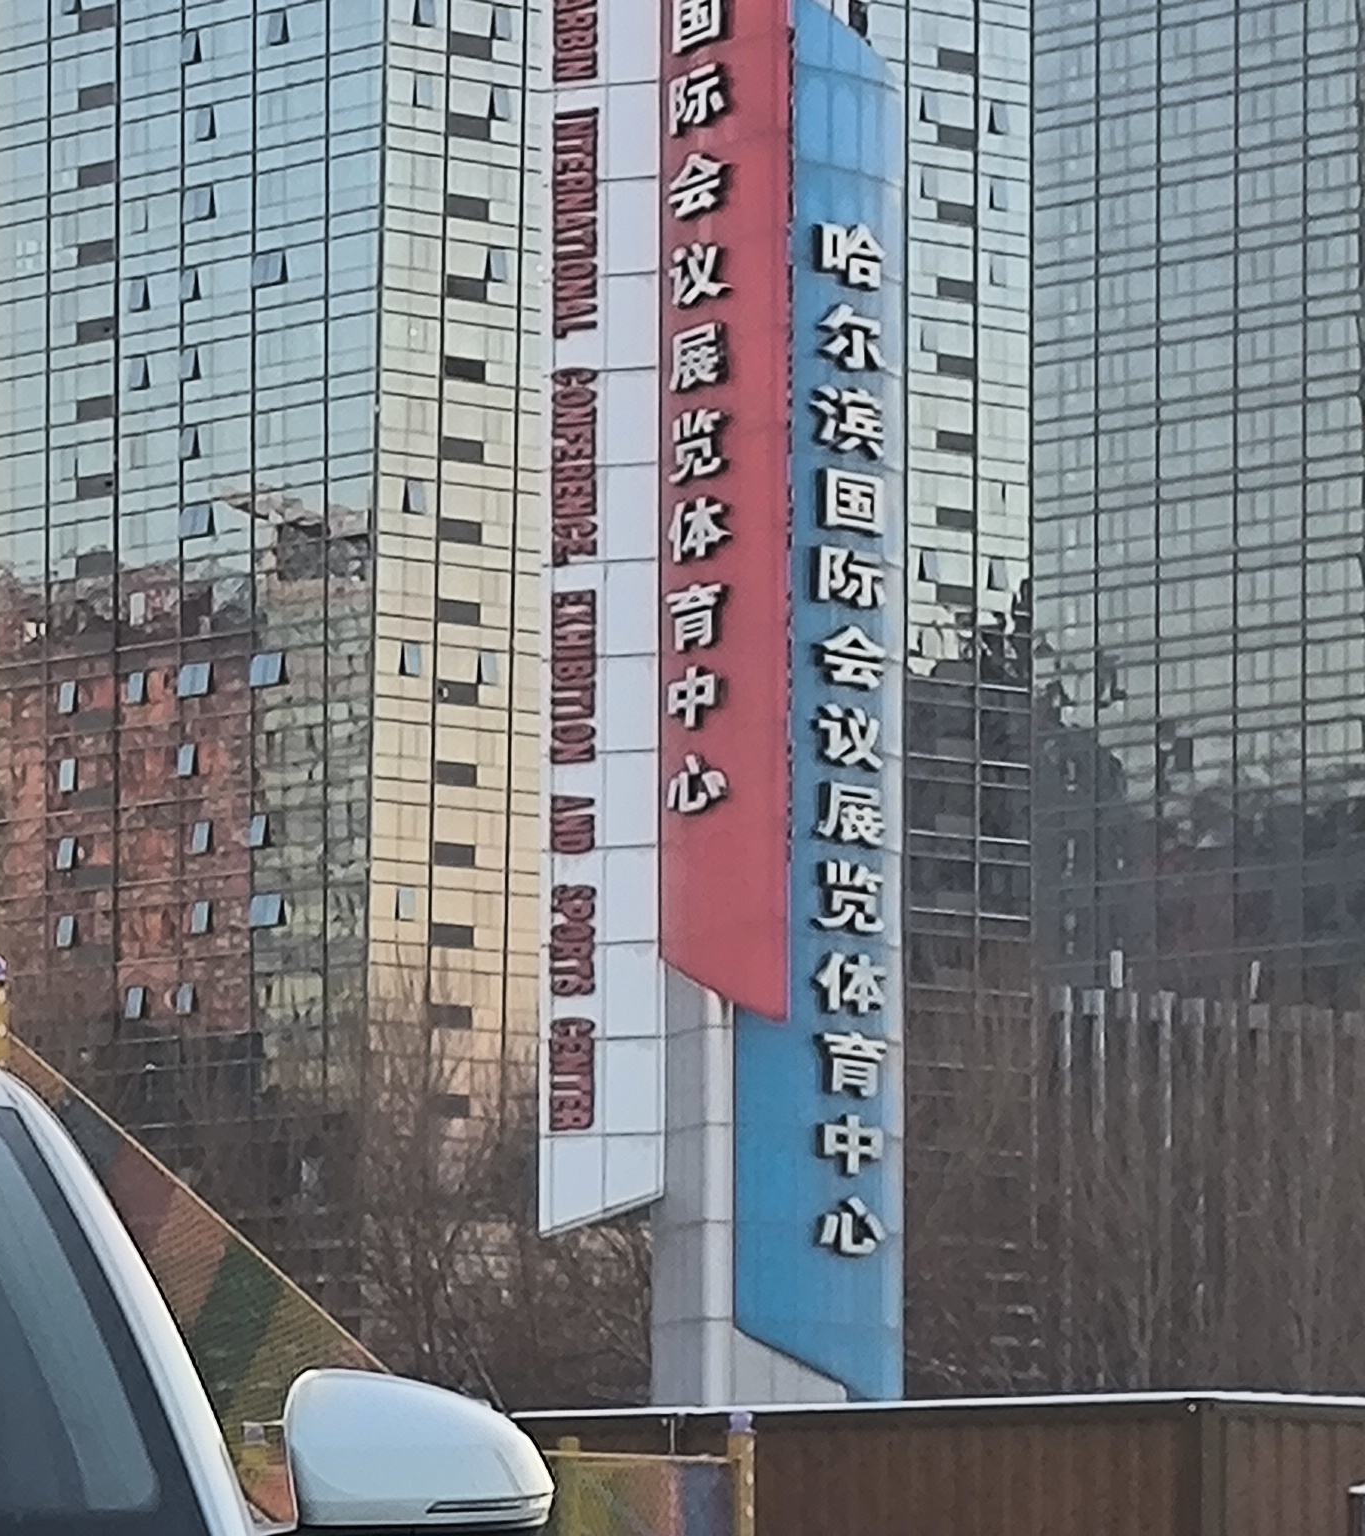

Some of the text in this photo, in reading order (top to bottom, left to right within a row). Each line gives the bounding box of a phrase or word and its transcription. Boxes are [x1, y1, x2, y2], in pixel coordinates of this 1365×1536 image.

[552, 107, 599, 339] INTERNATIONAL
[551, 366, 598, 567] CONFERENCE
[666, 0, 733, 812] 国际会议展览体育中心
[550, 588, 597, 764] EXHIBITION
[812, 222, 887, 1257] 哈尔滨国际会议展览体育中心
[549, 795, 595, 853] AND
[549, 884, 597, 996] SPORTS
[548, 1016, 596, 1132] CENTER
